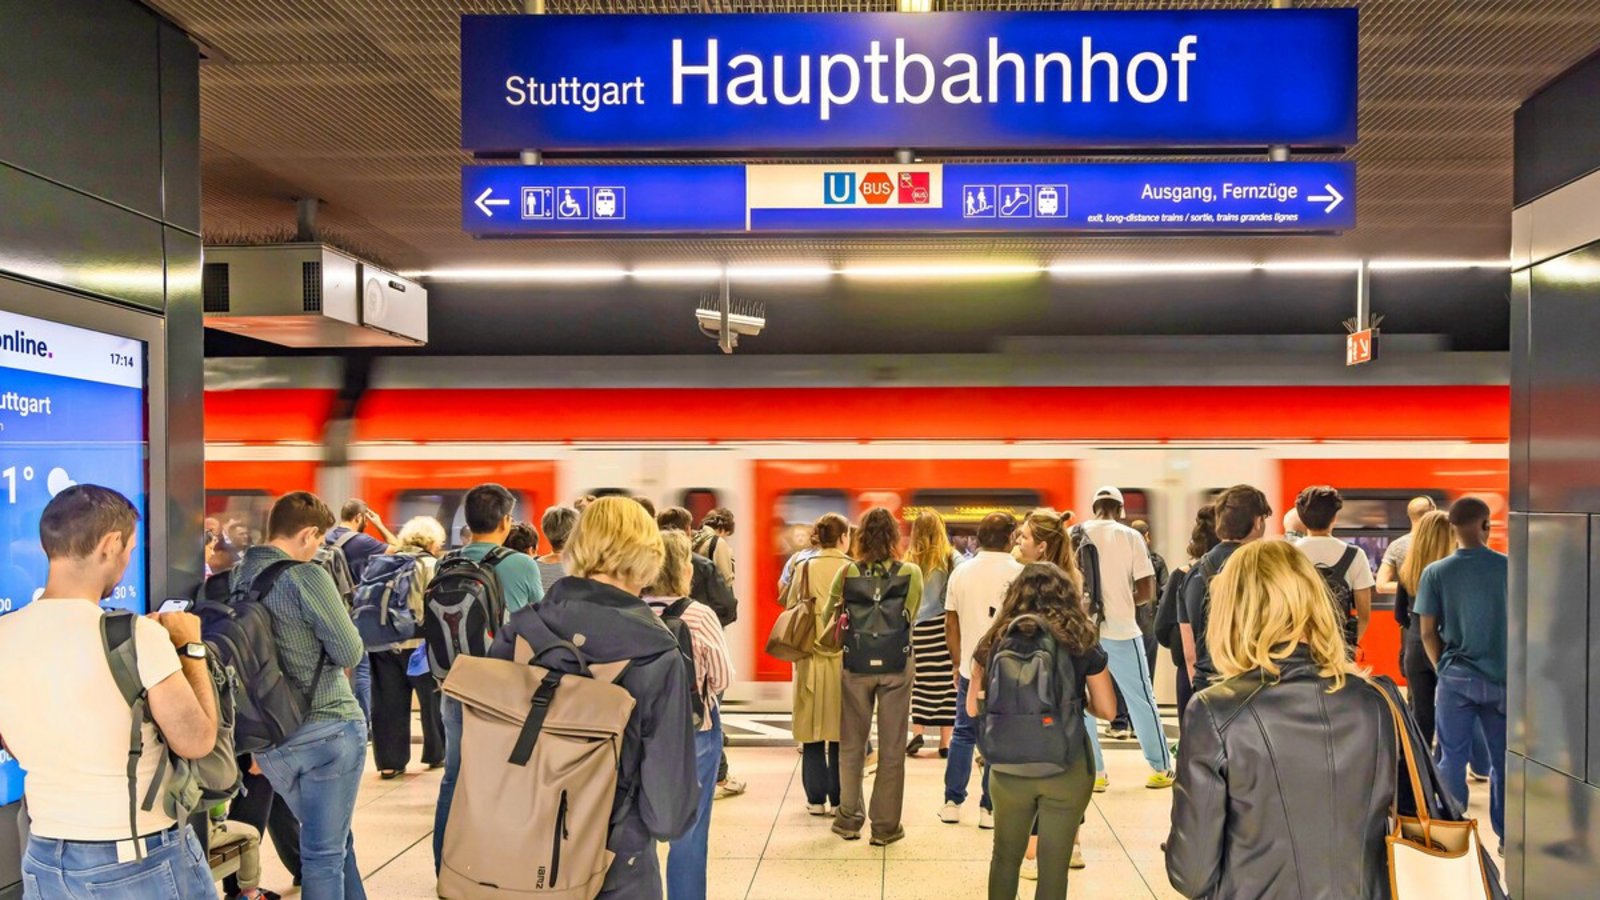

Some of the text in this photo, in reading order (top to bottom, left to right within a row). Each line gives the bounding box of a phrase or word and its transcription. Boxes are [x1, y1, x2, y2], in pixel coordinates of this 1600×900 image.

[505, 35, 1197, 121] Stuttgart Hauptbahnhof
[829, 174, 850, 203] U
[863, 182, 891, 195] BUS
[1141, 183, 1298, 203] Ausgang, Fernzüge
[1105, 213, 1160, 224] long-distance
[1161, 213, 1184, 222] trains
[1190, 213, 1215, 223] sortie,
[1216, 213, 1239, 222] trains
[1240, 213, 1273, 223] grandes
[1274, 213, 1298, 223] lignes
[0, 330, 53, 358] nline.
[110, 353, 134, 368] 17:14
[113, 586, 127, 600] 30
